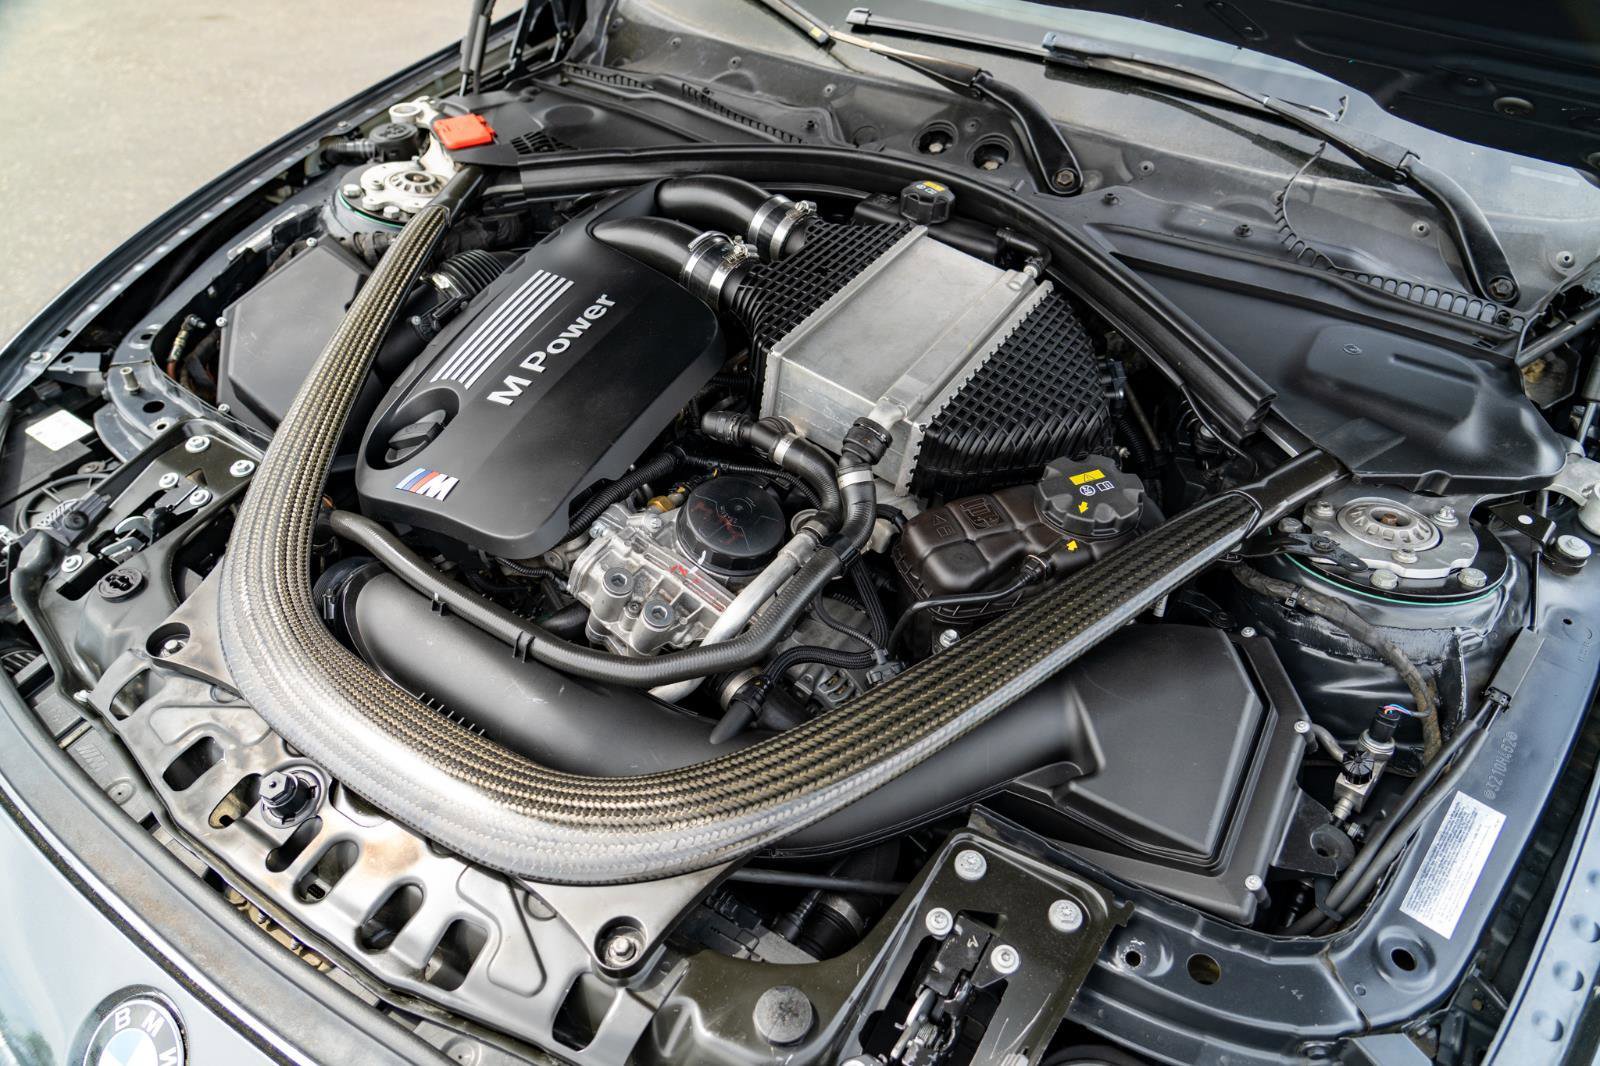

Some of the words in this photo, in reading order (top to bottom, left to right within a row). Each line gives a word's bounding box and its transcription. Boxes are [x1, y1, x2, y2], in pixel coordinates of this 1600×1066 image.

[486, 375, 532, 406] M
[519, 294, 616, 373] Power
[408, 471, 460, 502] M
